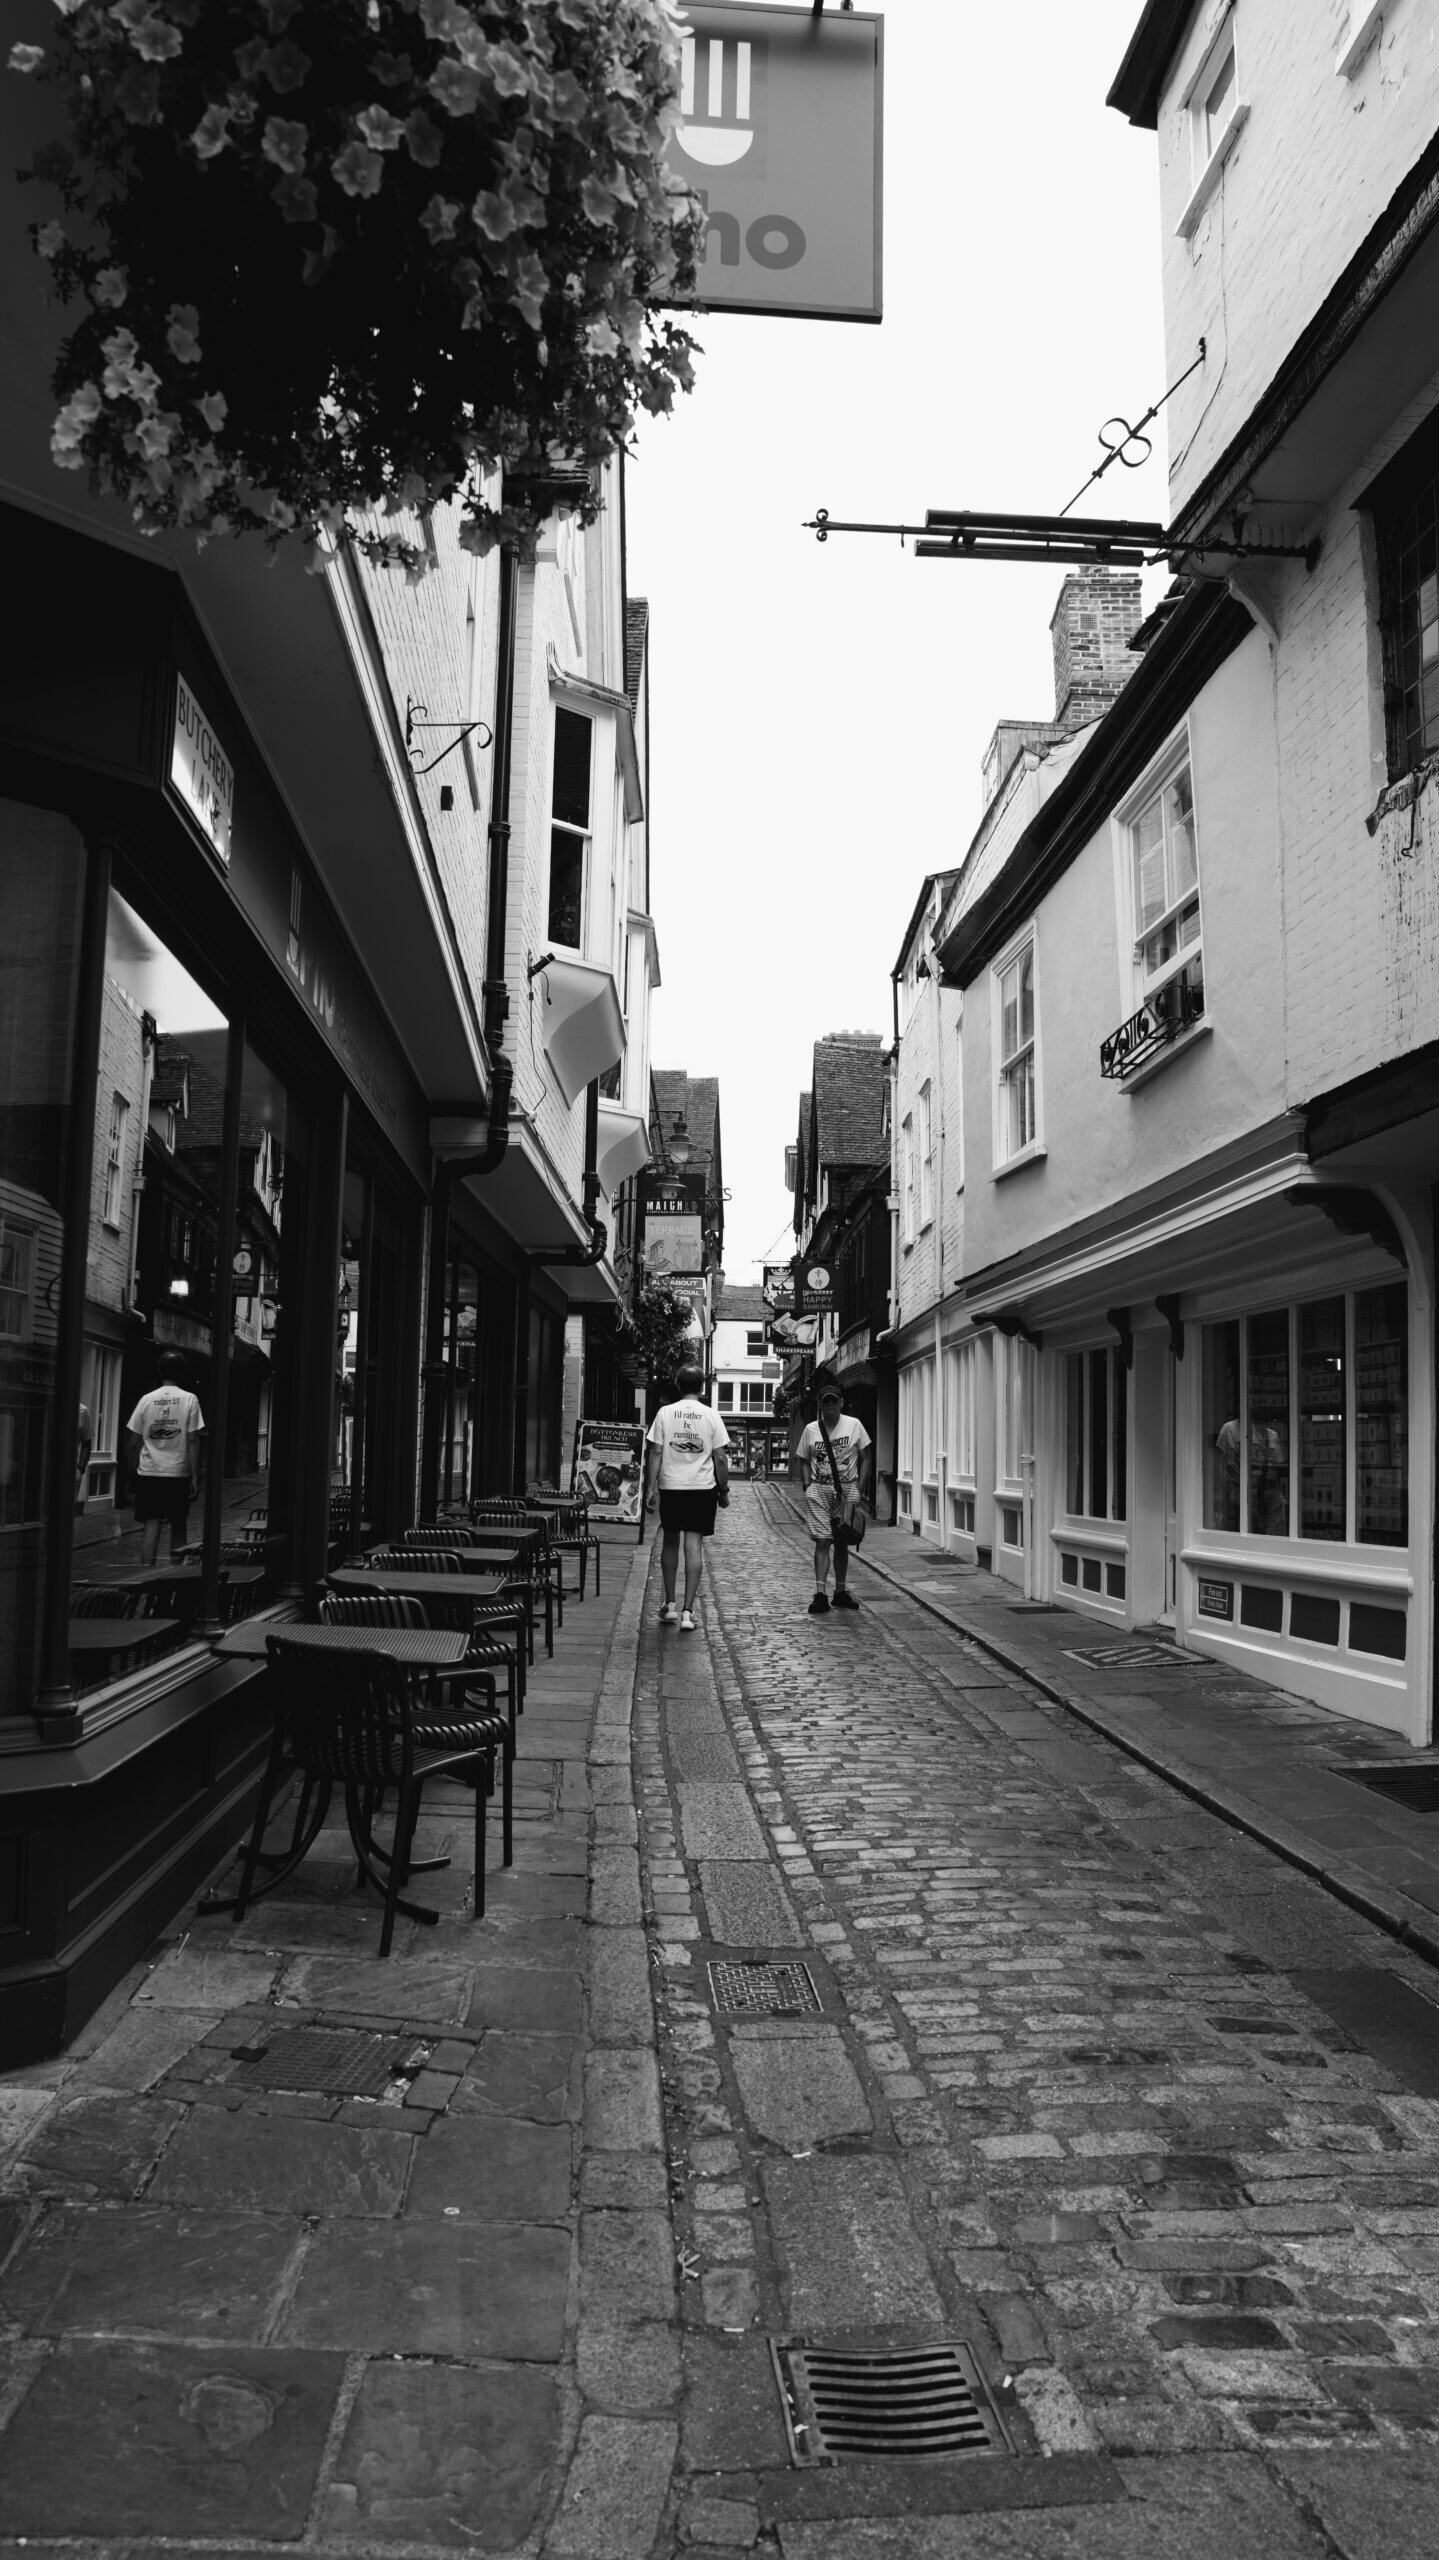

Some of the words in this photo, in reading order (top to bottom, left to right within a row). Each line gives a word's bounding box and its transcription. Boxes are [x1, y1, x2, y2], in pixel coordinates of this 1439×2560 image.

[695, 188, 807, 271] ho
[178, 685, 234, 807] BUTCHERY
[190, 759, 220, 834] LANE
[648, 1225, 696, 1235] TERRACE
[802, 1296, 833, 1304] HAPPY
[674, 1410, 682, 1419] I'd
[683, 1411, 703, 1420] rather
[683, 1420, 692, 1429] be
[590, 1428, 637, 1438] BOTTOMLESS
[600, 1434, 628, 1442] BRUNCH
